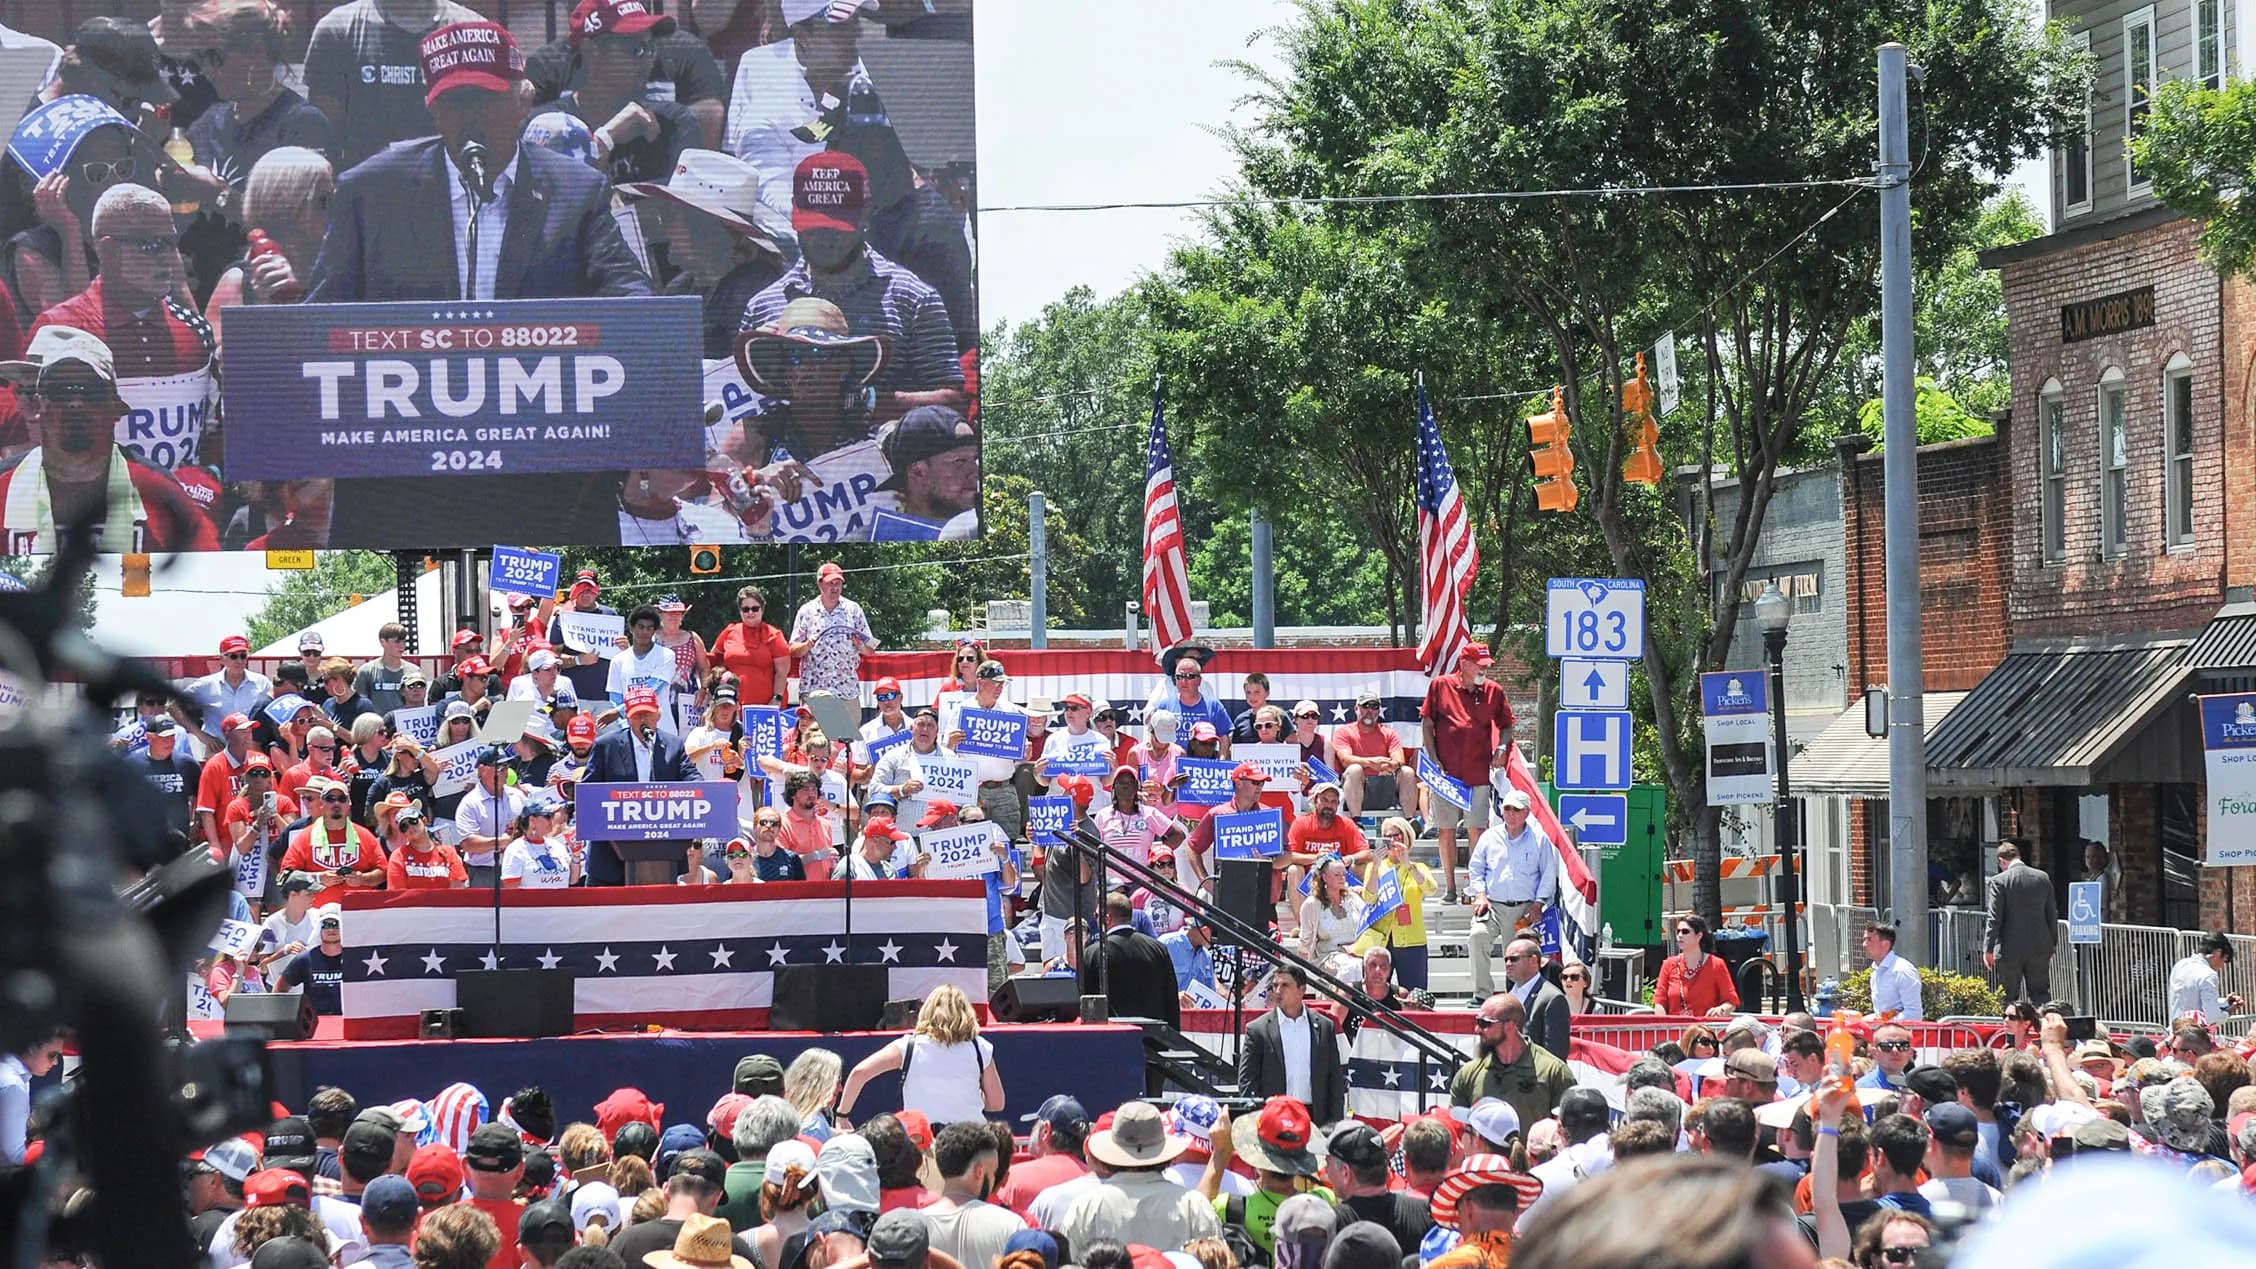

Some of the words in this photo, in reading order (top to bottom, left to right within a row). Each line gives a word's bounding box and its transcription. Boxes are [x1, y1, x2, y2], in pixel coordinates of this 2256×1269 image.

[422, 33, 450, 57] MAKE
[449, 28, 501, 46] AMERICA
[428, 51, 459, 73] GREAT
[461, 48, 497, 63] AGAIN
[380, 65, 417, 85] CHRIST
[811, 168, 840, 179] KEEP
[803, 180, 851, 192] AMERICA
[807, 193, 845, 204] GREAT
[2089, 298, 2130, 332] MORRIS
[349, 330, 412, 350] TEXT
[420, 329, 453, 349] SC
[460, 329, 493, 347] TO
[501, 326, 578, 347] 88022
[303, 355, 626, 420] TRUMP
[128, 401, 206, 440] RUM
[321, 431, 375, 445] MAKE
[382, 429, 468, 443] AMERICA
[476, 427, 537, 441] GREAT
[544, 424, 611, 439] AGAIN!
[431, 450, 503, 471] 2024
[278, 556, 301, 564] GREEN
[499, 555, 554, 572] TRUMP
[504, 566, 544, 583] 2024
[1607, 581, 1640, 589] CAROLINA
[1795, 573, 1819, 597] FIRM
[572, 625, 597, 634] STAND
[599, 628, 620, 636] WITH
[1563, 610, 1627, 652] 183
[1717, 695, 1752, 706] Pickens
[966, 716, 1021, 733] TRUMP
[971, 730, 1012, 745] 2024
[1056, 751, 1096, 762] 2024
[1567, 717, 1620, 784] H
[920, 764, 973, 779] TRUMP
[928, 776, 965, 790] 2024
[1190, 778, 1231, 790] 2024
[617, 791, 639, 799] TEXT
[601, 801, 712, 822] TRUMP
[644, 831, 669, 839] 2024
[1225, 826, 1253, 834] STAND
[1255, 822, 1277, 830] WITH
[930, 833, 987, 853] TRUMP
[1220, 831, 1278, 848] TRUMP
[1305, 841, 1341, 852] TRUMP
[940, 847, 981, 864] 2024
[2219, 850, 2242, 858] SHOP
[238, 853, 251, 883] 024
[2072, 925, 2098, 936] PARKING
